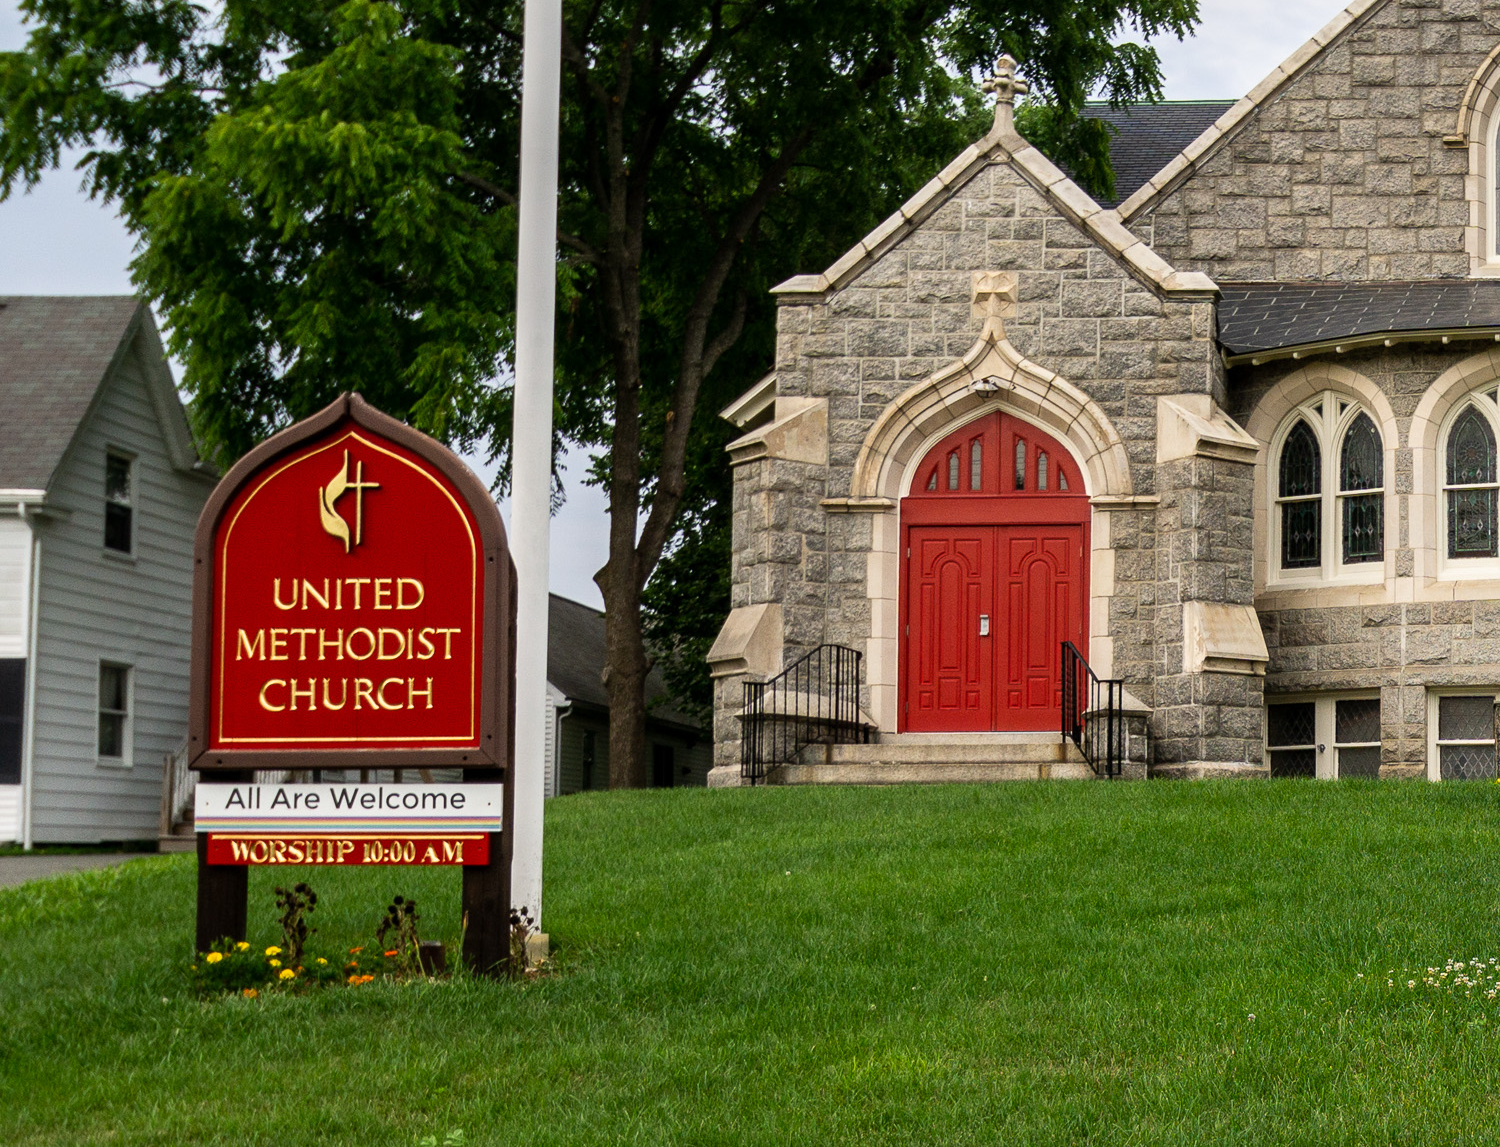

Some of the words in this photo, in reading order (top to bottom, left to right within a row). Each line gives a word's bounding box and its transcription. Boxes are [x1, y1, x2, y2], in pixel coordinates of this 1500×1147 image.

[273, 578, 424, 610] UNITED
[236, 627, 461, 661] METHODIST
[259, 677, 434, 712] CHURCH
[225, 787, 260, 809] All
[270, 788, 320, 809] Are
[330, 787, 466, 809] Welcome
[230, 840, 355, 864] WORSHIP
[362, 841, 416, 863] 10:00
